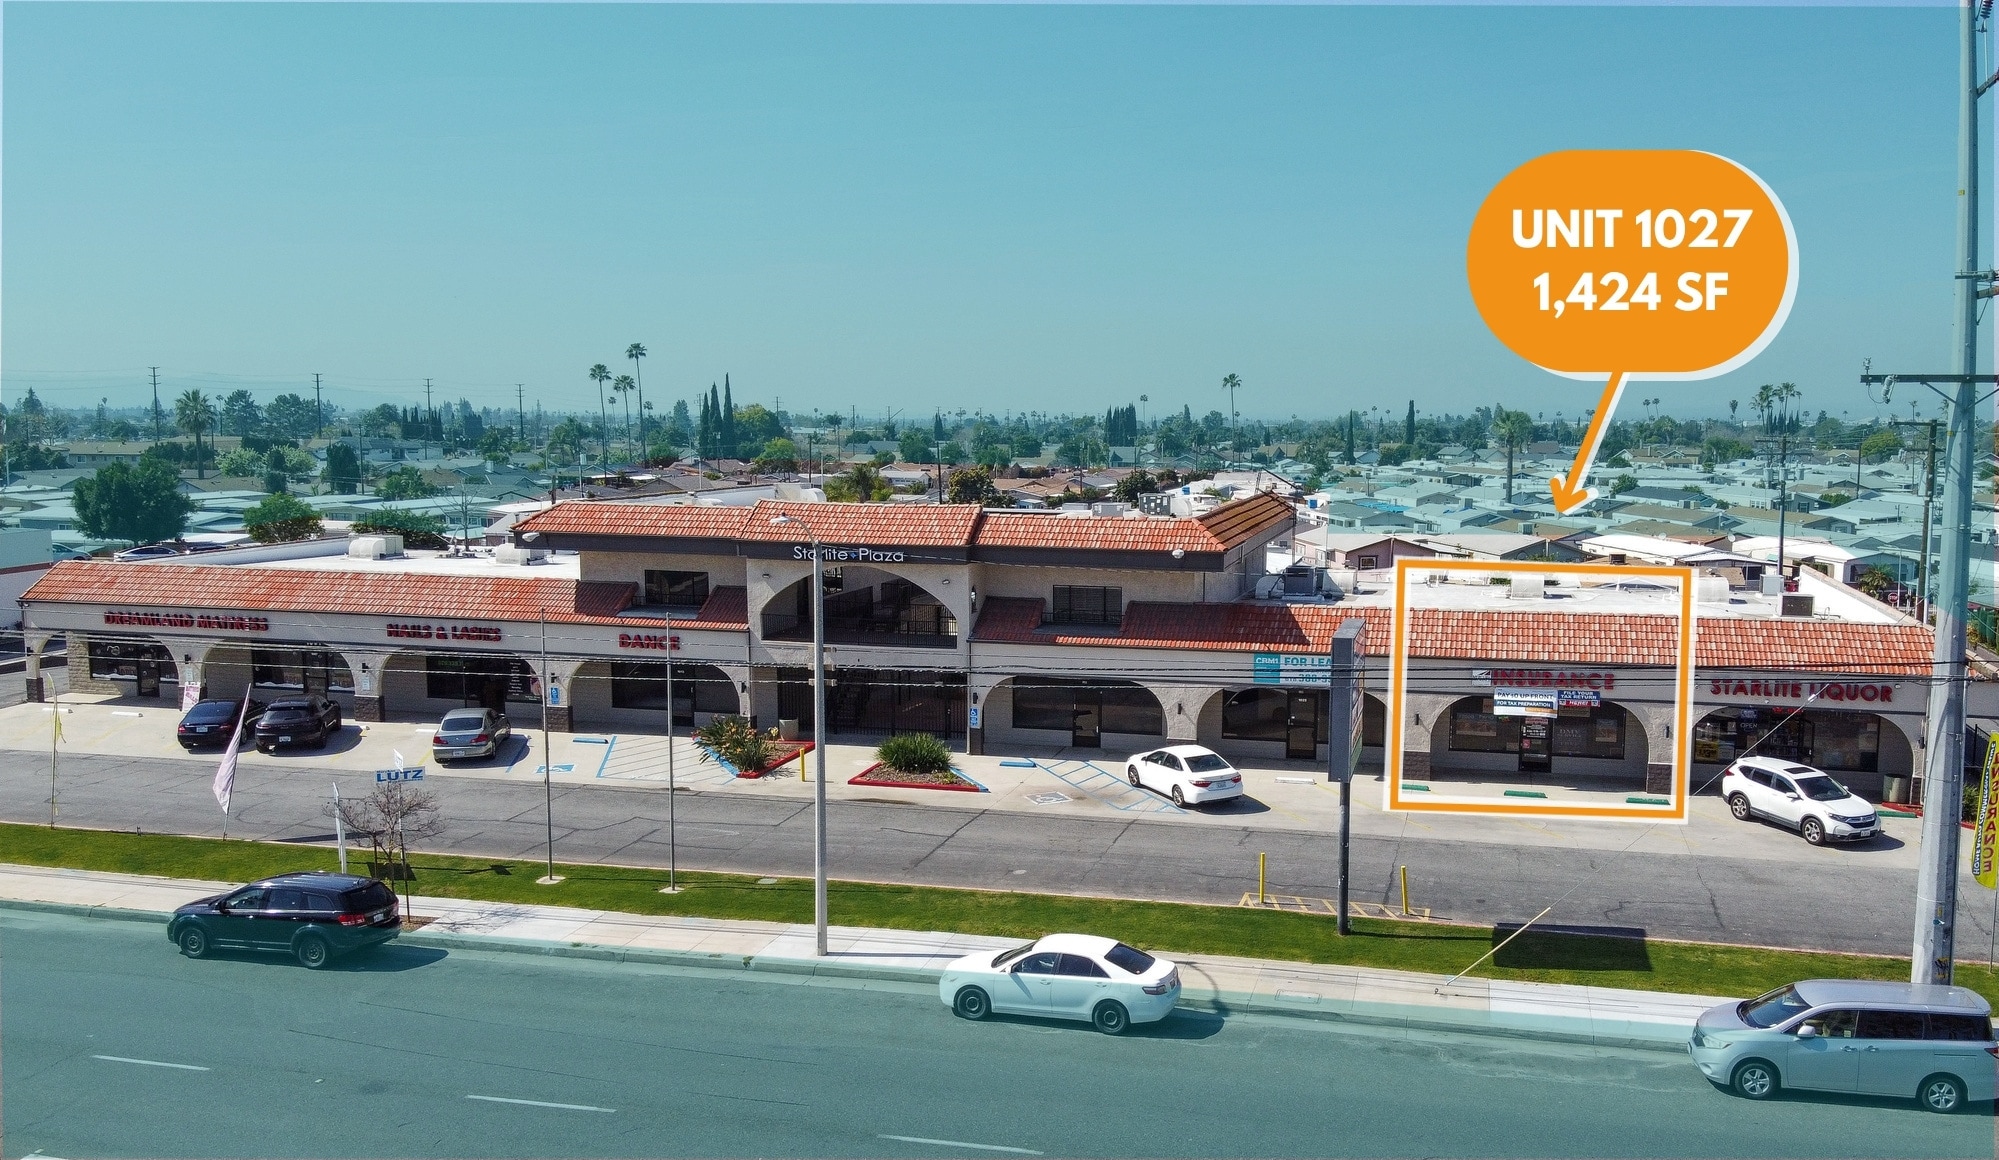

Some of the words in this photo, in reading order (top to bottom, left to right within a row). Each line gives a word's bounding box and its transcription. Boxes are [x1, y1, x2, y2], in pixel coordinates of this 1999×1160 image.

[858, 547, 904, 562] Plaza
[104, 611, 195, 629] DREAMLAND
[196, 615, 269, 632] MATTRESS
[386, 623, 433, 639] NAILS
[435, 626, 448, 640] &
[451, 625, 502, 642] LASHES
[618, 633, 681, 651] DANCE
[1284, 657, 1307, 667] FOR
[1493, 669, 1615, 691] INSURANCE
[1710, 679, 1802, 698] STARLITE
[1809, 682, 1893, 702] LIQUOR
[376, 769, 424, 783] LUTZ
